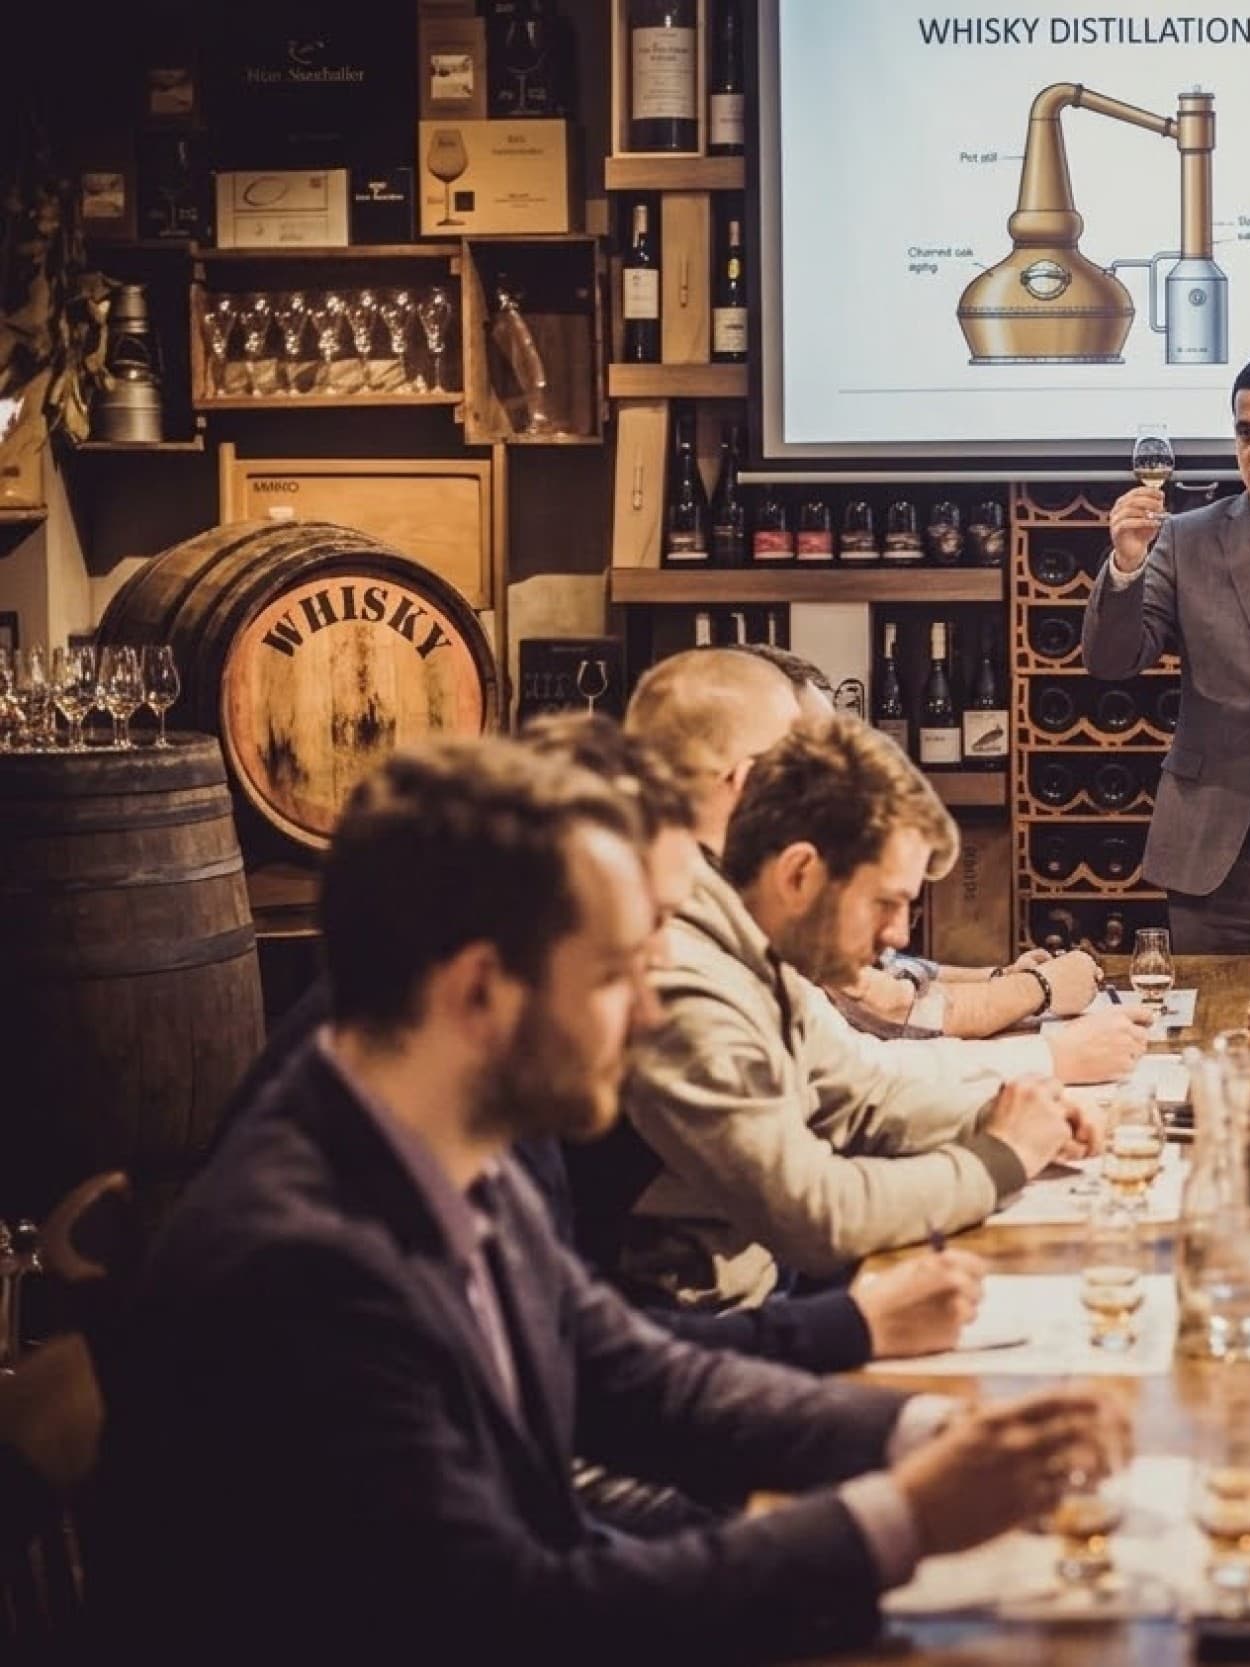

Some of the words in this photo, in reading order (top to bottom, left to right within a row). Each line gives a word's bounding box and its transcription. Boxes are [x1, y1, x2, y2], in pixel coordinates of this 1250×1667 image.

[918, 17, 1040, 45] WHISKY
[1050, 17, 1250, 45] DISTILLATION
[261, 583, 453, 660] WHISKY
